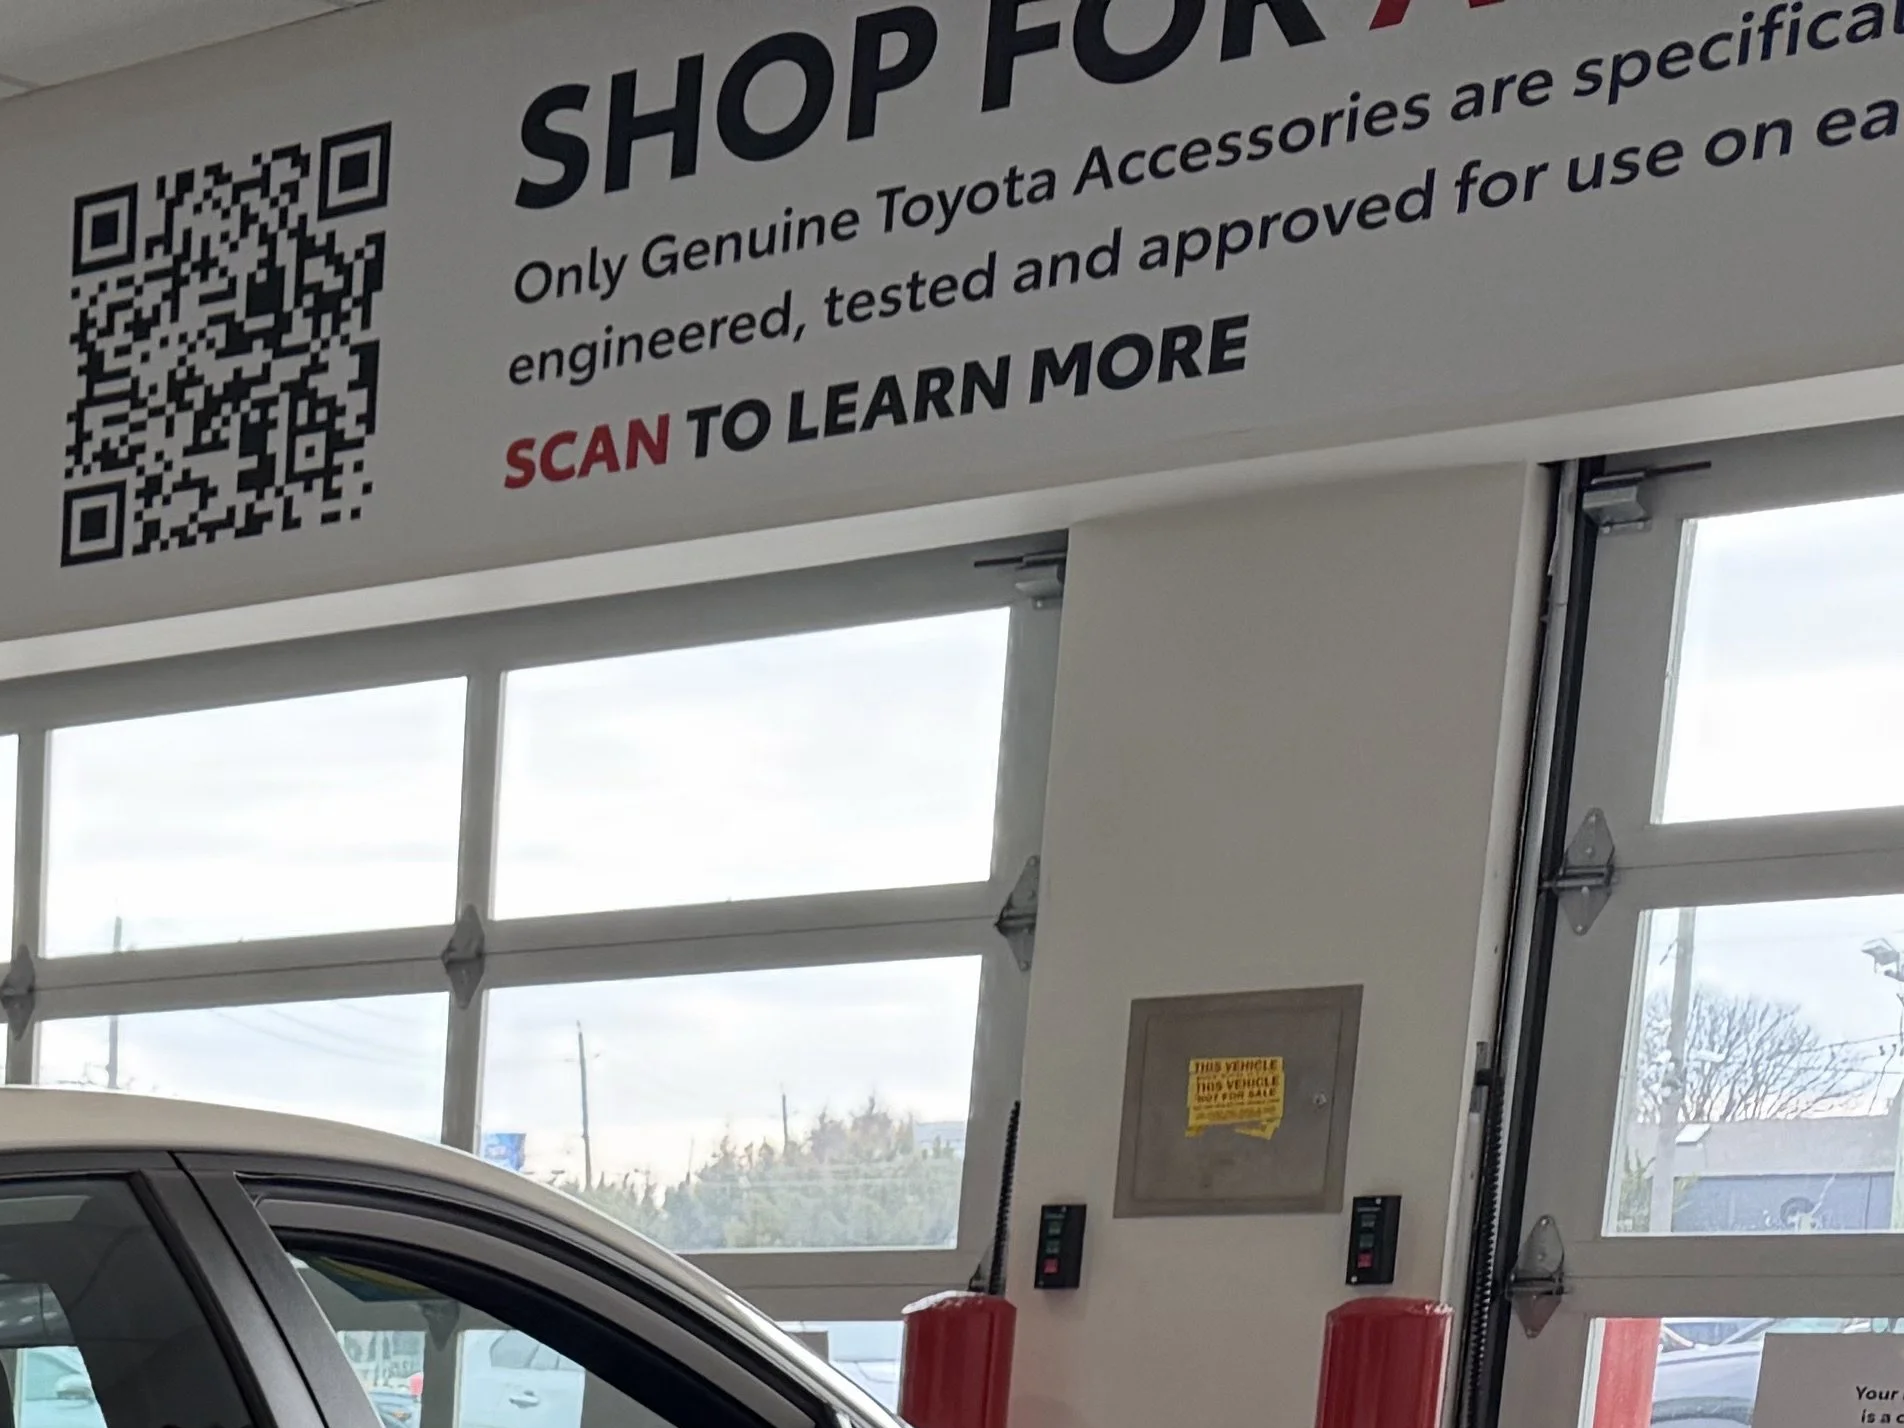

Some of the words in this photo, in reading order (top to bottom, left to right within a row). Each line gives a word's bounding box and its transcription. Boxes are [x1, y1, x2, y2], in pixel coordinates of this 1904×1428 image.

[514, 4, 938, 210] SHOP
[515, 247, 628, 303] Only
[642, 208, 859, 279] Genuine
[877, 165, 1057, 237] Toyota
[1073, 91, 1431, 195] Accessories
[1450, 68, 1554, 121] are
[508, 290, 806, 386] engineered,
[824, 251, 997, 328] tested
[1013, 227, 1123, 293] and
[1138, 168, 1436, 277] approved
[1455, 158, 1548, 215] for
[1567, 138, 1684, 193] use
[1704, 115, 1793, 168] on
[503, 413, 670, 490] SCAN
[687, 397, 772, 459] TO
[786, 356, 1010, 445] LEARN
[1028, 313, 1249, 405] MORE
[1226, 1059, 1279, 1072] VEHICLE
[1226, 1075, 1279, 1090] VEHICLE
[1856, 1385, 1899, 1400] Your
[1861, 1409, 1875, 1424] is
[1880, 1413, 1891, 1424] a
